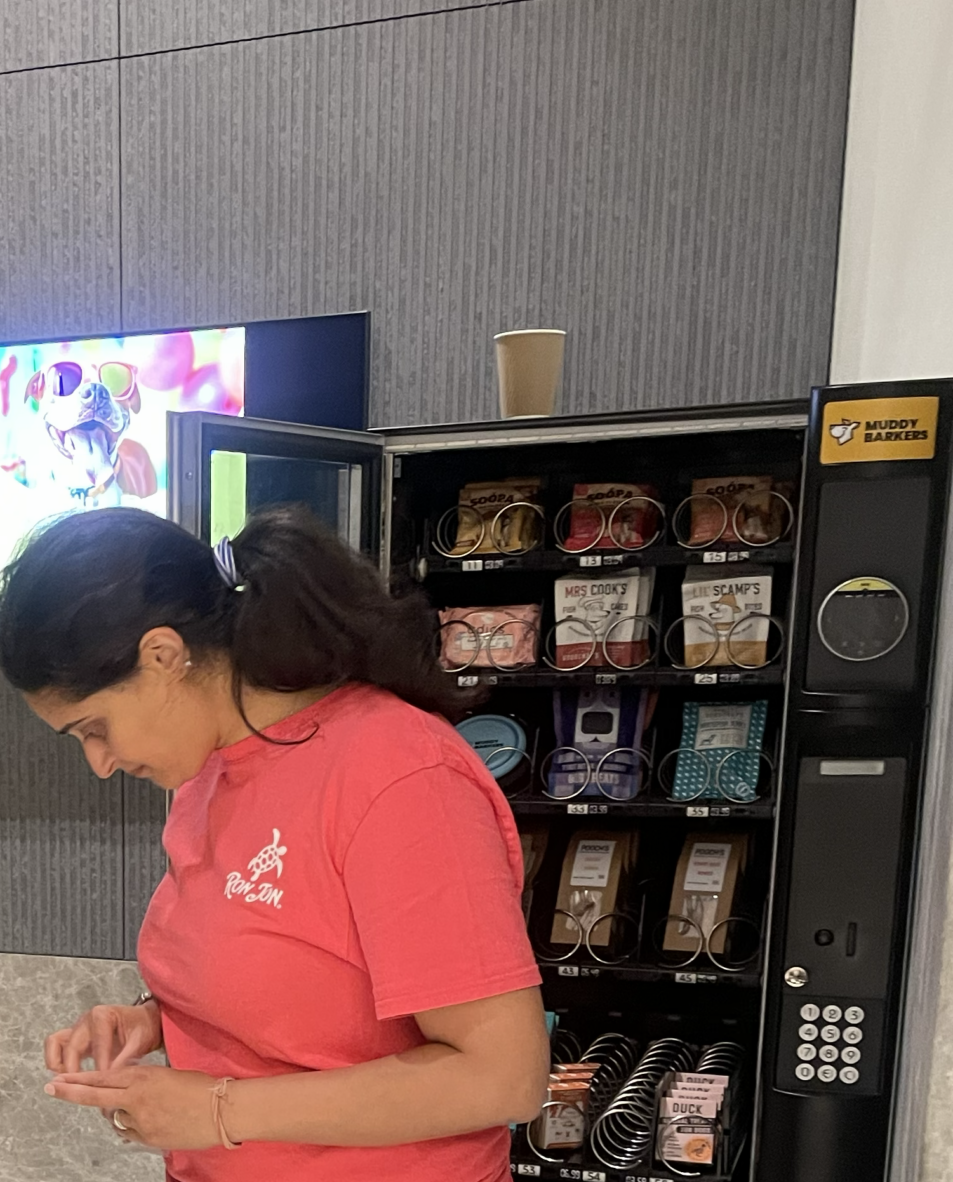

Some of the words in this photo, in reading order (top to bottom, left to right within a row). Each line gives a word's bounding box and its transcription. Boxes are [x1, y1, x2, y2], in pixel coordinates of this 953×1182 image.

[865, 419, 919, 431] MUDDY
[864, 430, 928, 443] BARKERS
[564, 585, 587, 598] MRS
[590, 583, 628, 596] COOK'S
[713, 583, 761, 597] SCAMP'S
[672, 1103, 704, 1115] DUCK
